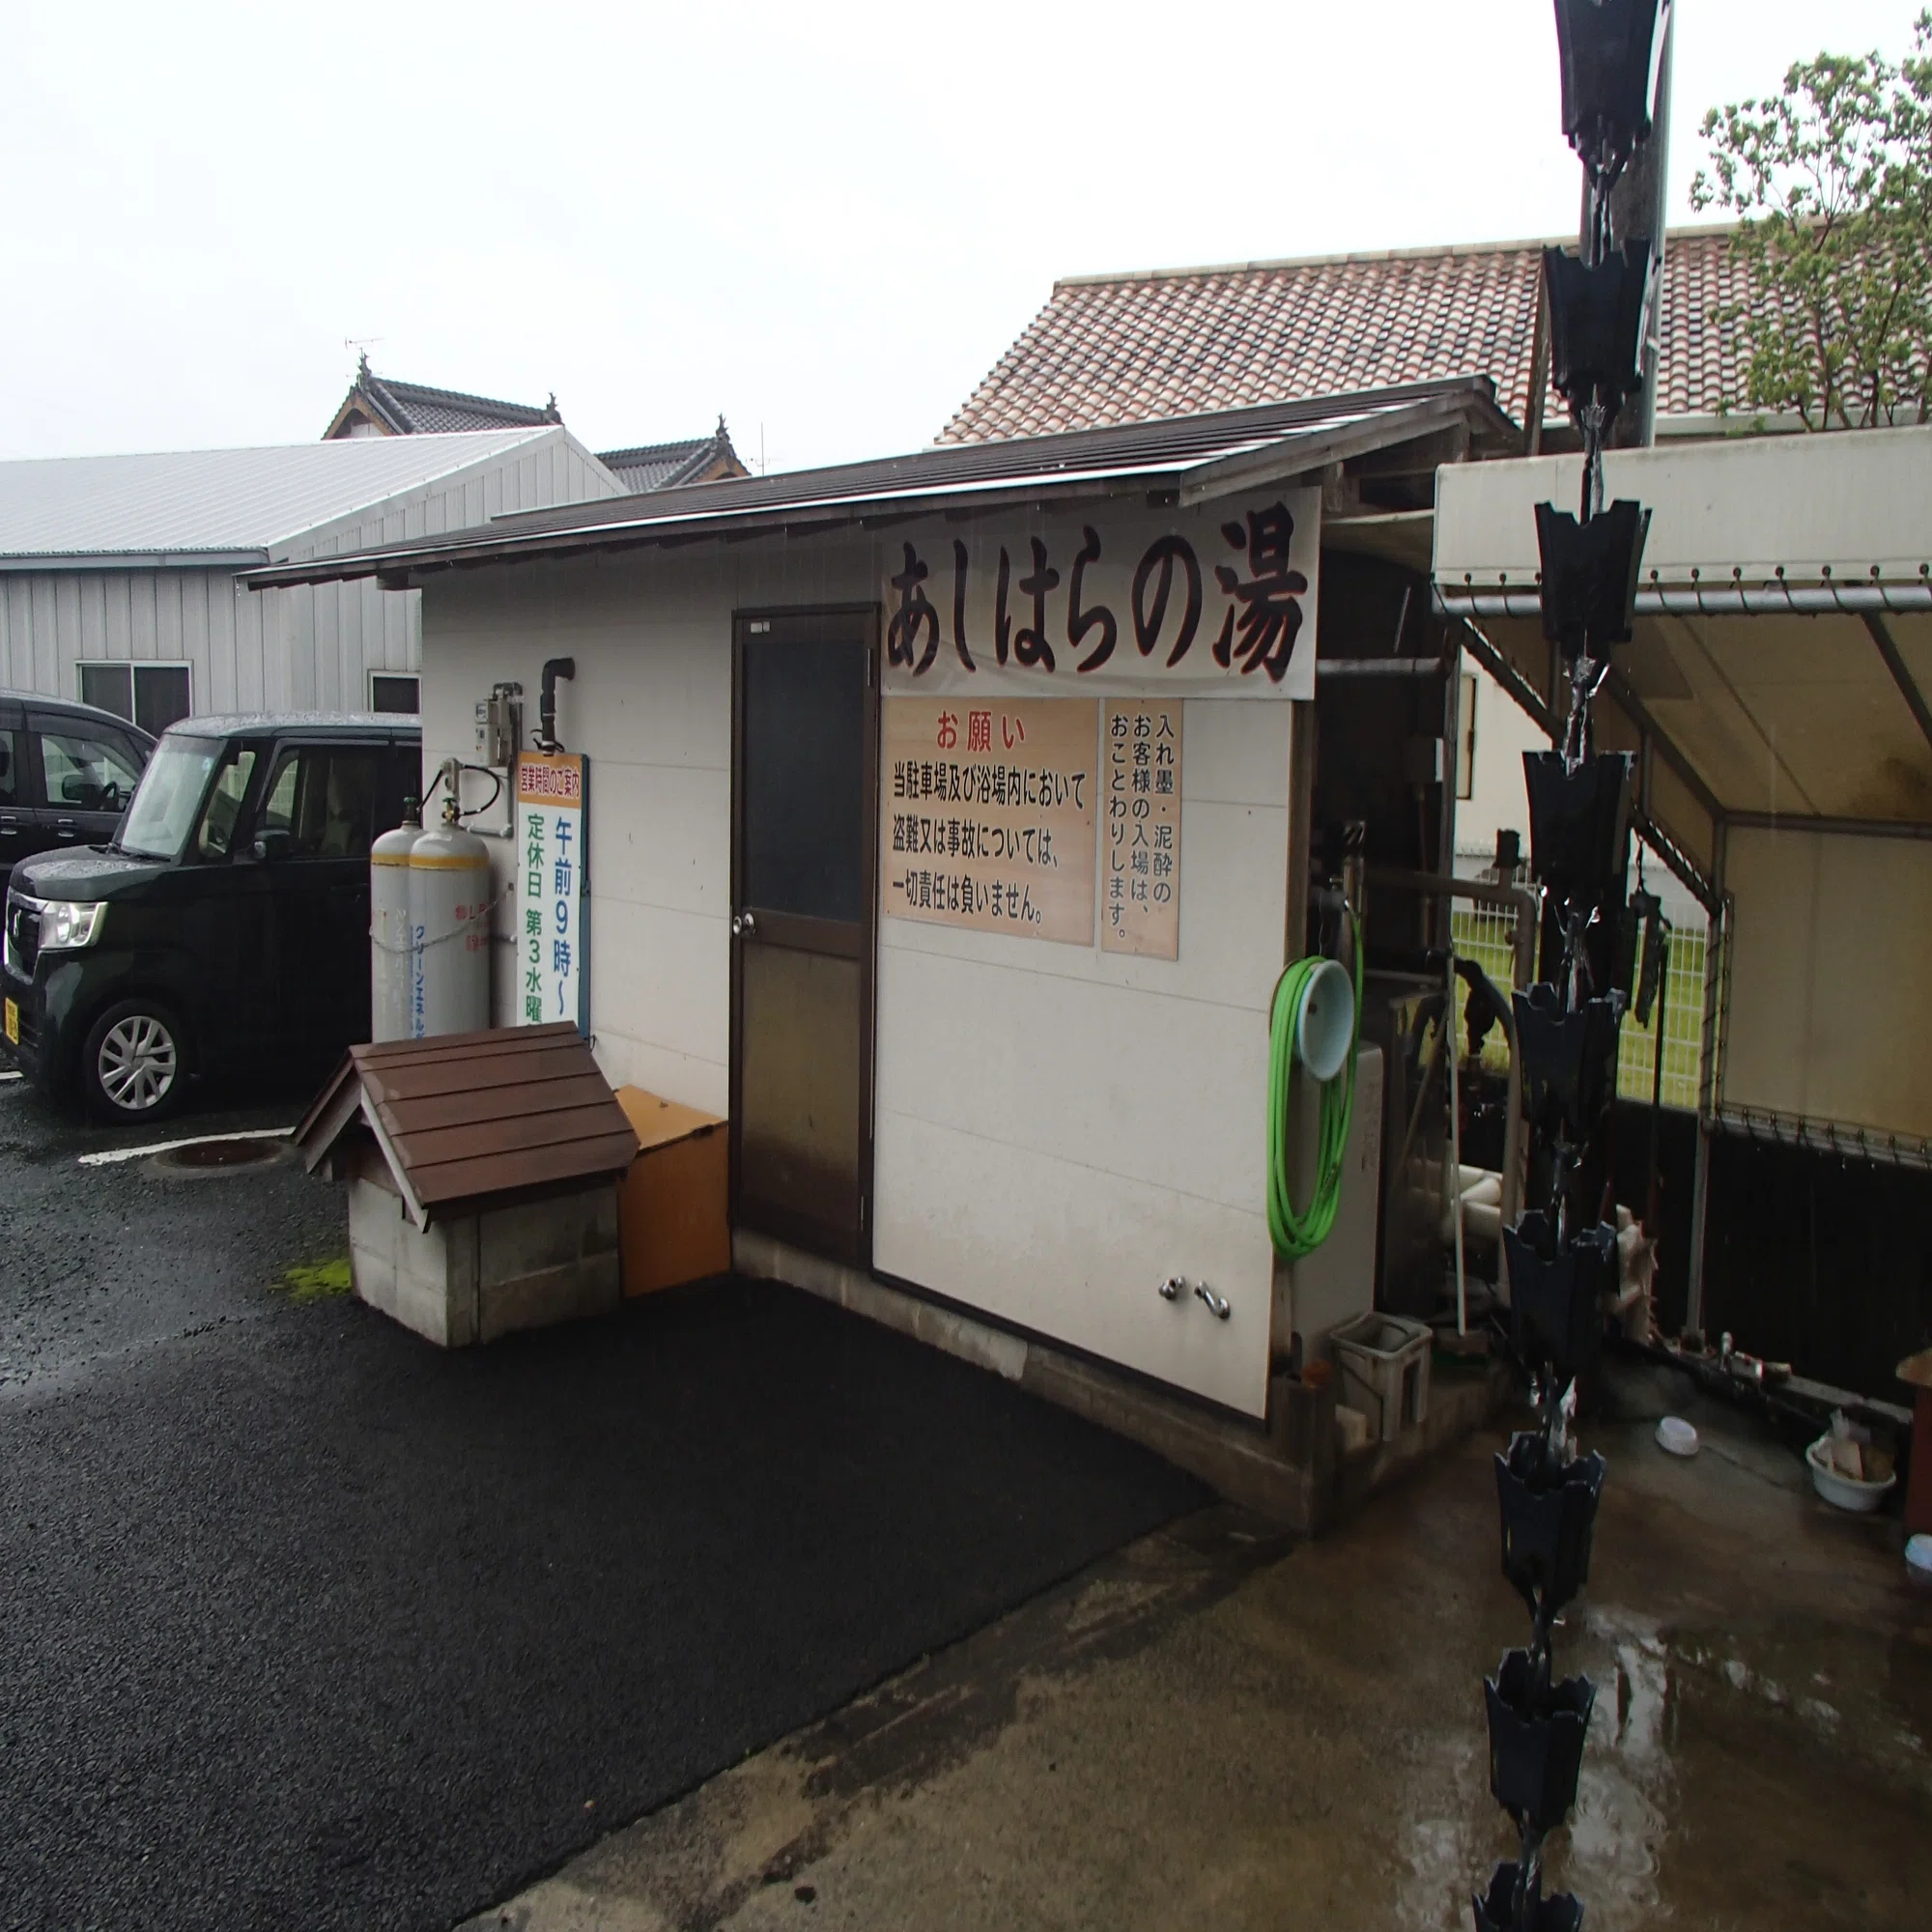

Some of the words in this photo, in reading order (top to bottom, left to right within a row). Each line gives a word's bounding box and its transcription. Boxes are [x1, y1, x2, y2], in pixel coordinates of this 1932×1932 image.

[888, 500, 1308, 684] あしはらの湯
[937, 710, 1025, 753] お願い
[522, 765, 580, 798] 営業時間のご案内
[894, 760, 1086, 810] 当駐車場及び浴場内において
[893, 813, 1059, 868] 盗難又は事故については、
[1109, 714, 1128, 939] おことわりします。
[1131, 714, 1151, 913] お客様の入場は、
[893, 868, 1041, 924] 一切責任は負いません。
[526, 909, 543, 1027] 第3水曜
